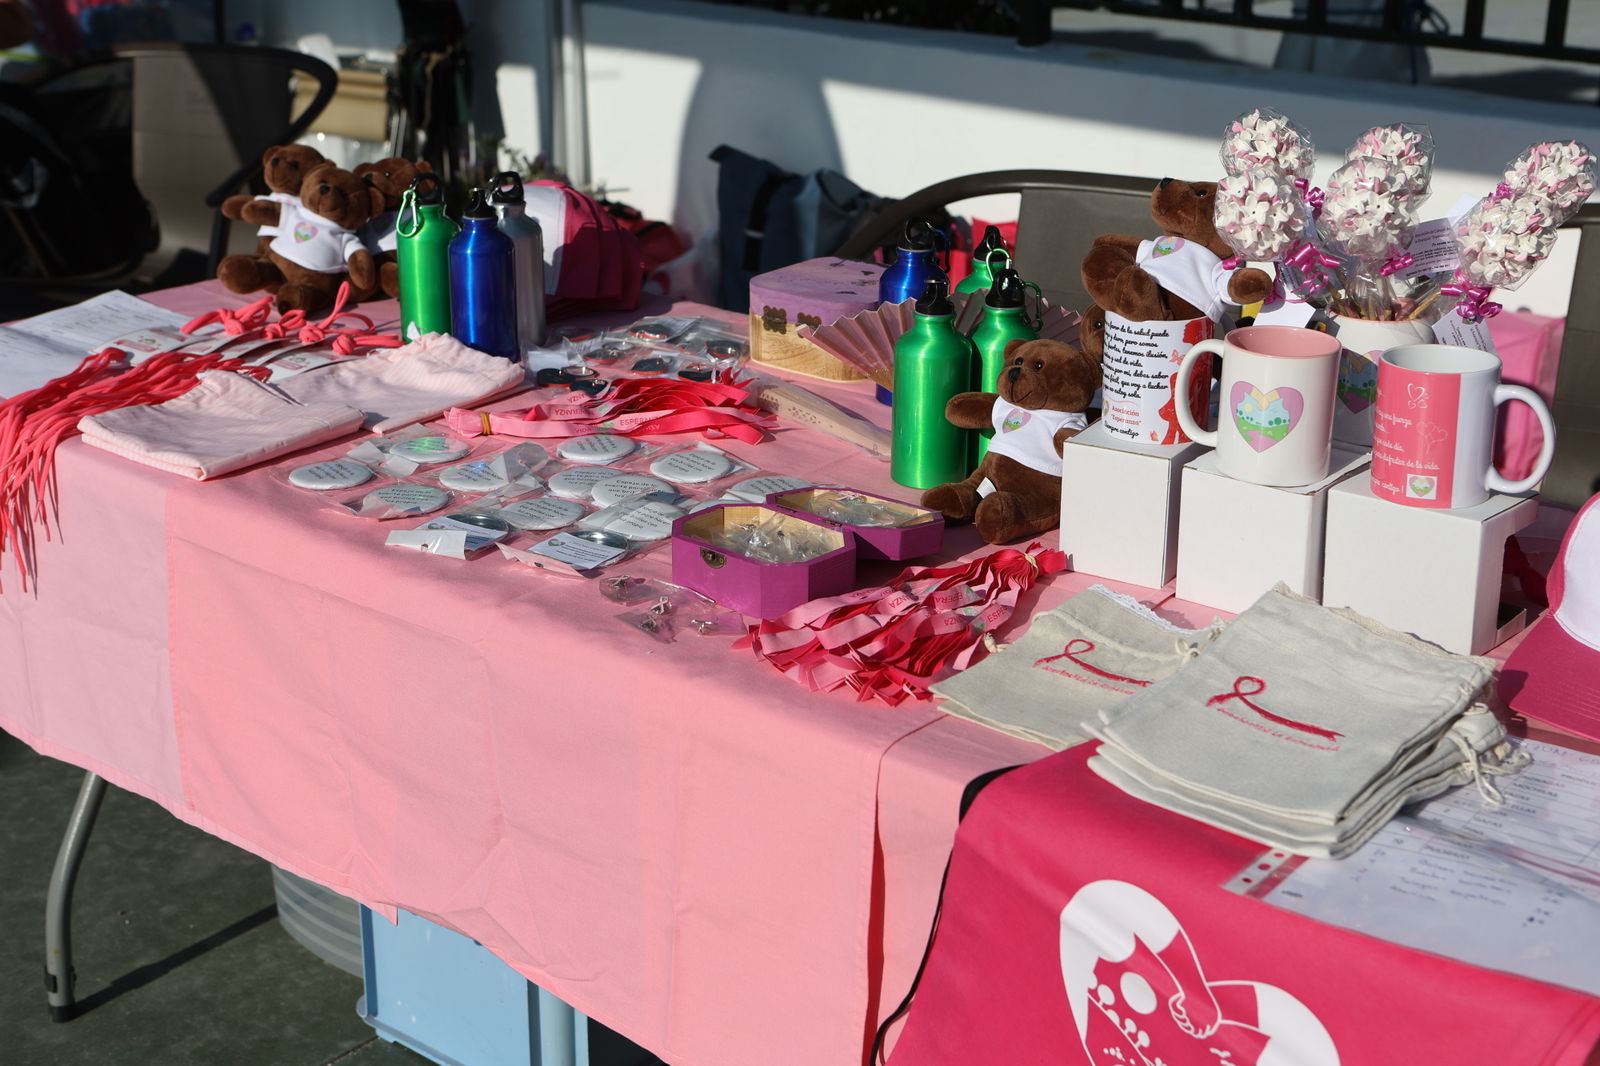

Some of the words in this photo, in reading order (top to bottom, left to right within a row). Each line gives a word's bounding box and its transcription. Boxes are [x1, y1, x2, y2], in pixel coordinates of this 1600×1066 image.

[1150, 329, 1170, 340] puede
[1122, 347, 1146, 356] tenemos
[1130, 382, 1142, 391] voy
[1148, 381, 1169, 390] luchar
